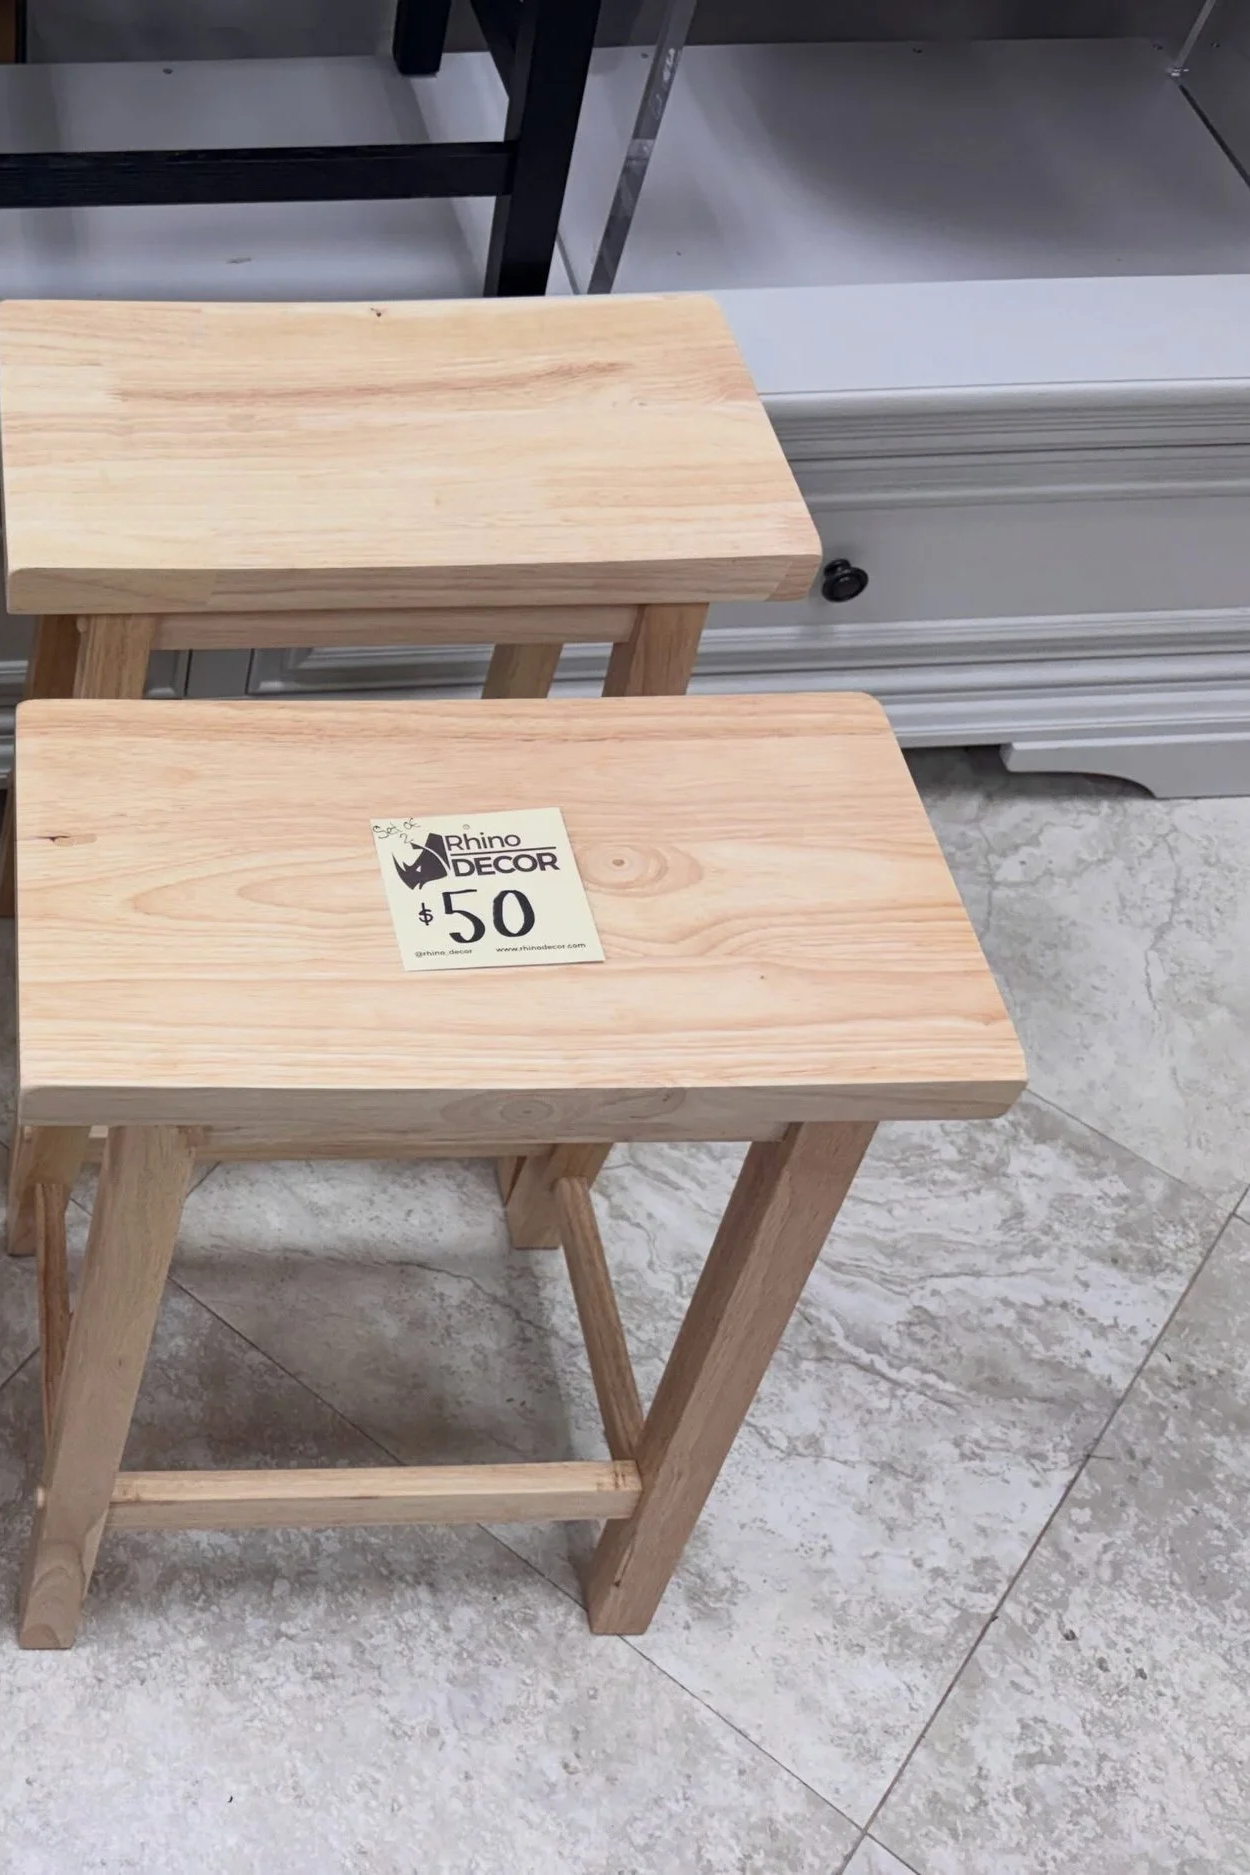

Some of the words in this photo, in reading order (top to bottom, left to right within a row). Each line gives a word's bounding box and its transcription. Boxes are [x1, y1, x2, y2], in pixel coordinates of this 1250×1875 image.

[448, 832, 521, 851] Rhino
[451, 852, 560, 877] DECOR
[418, 889, 536, 944] $50
[495, 942, 587, 953] www.rhinodecor.com
